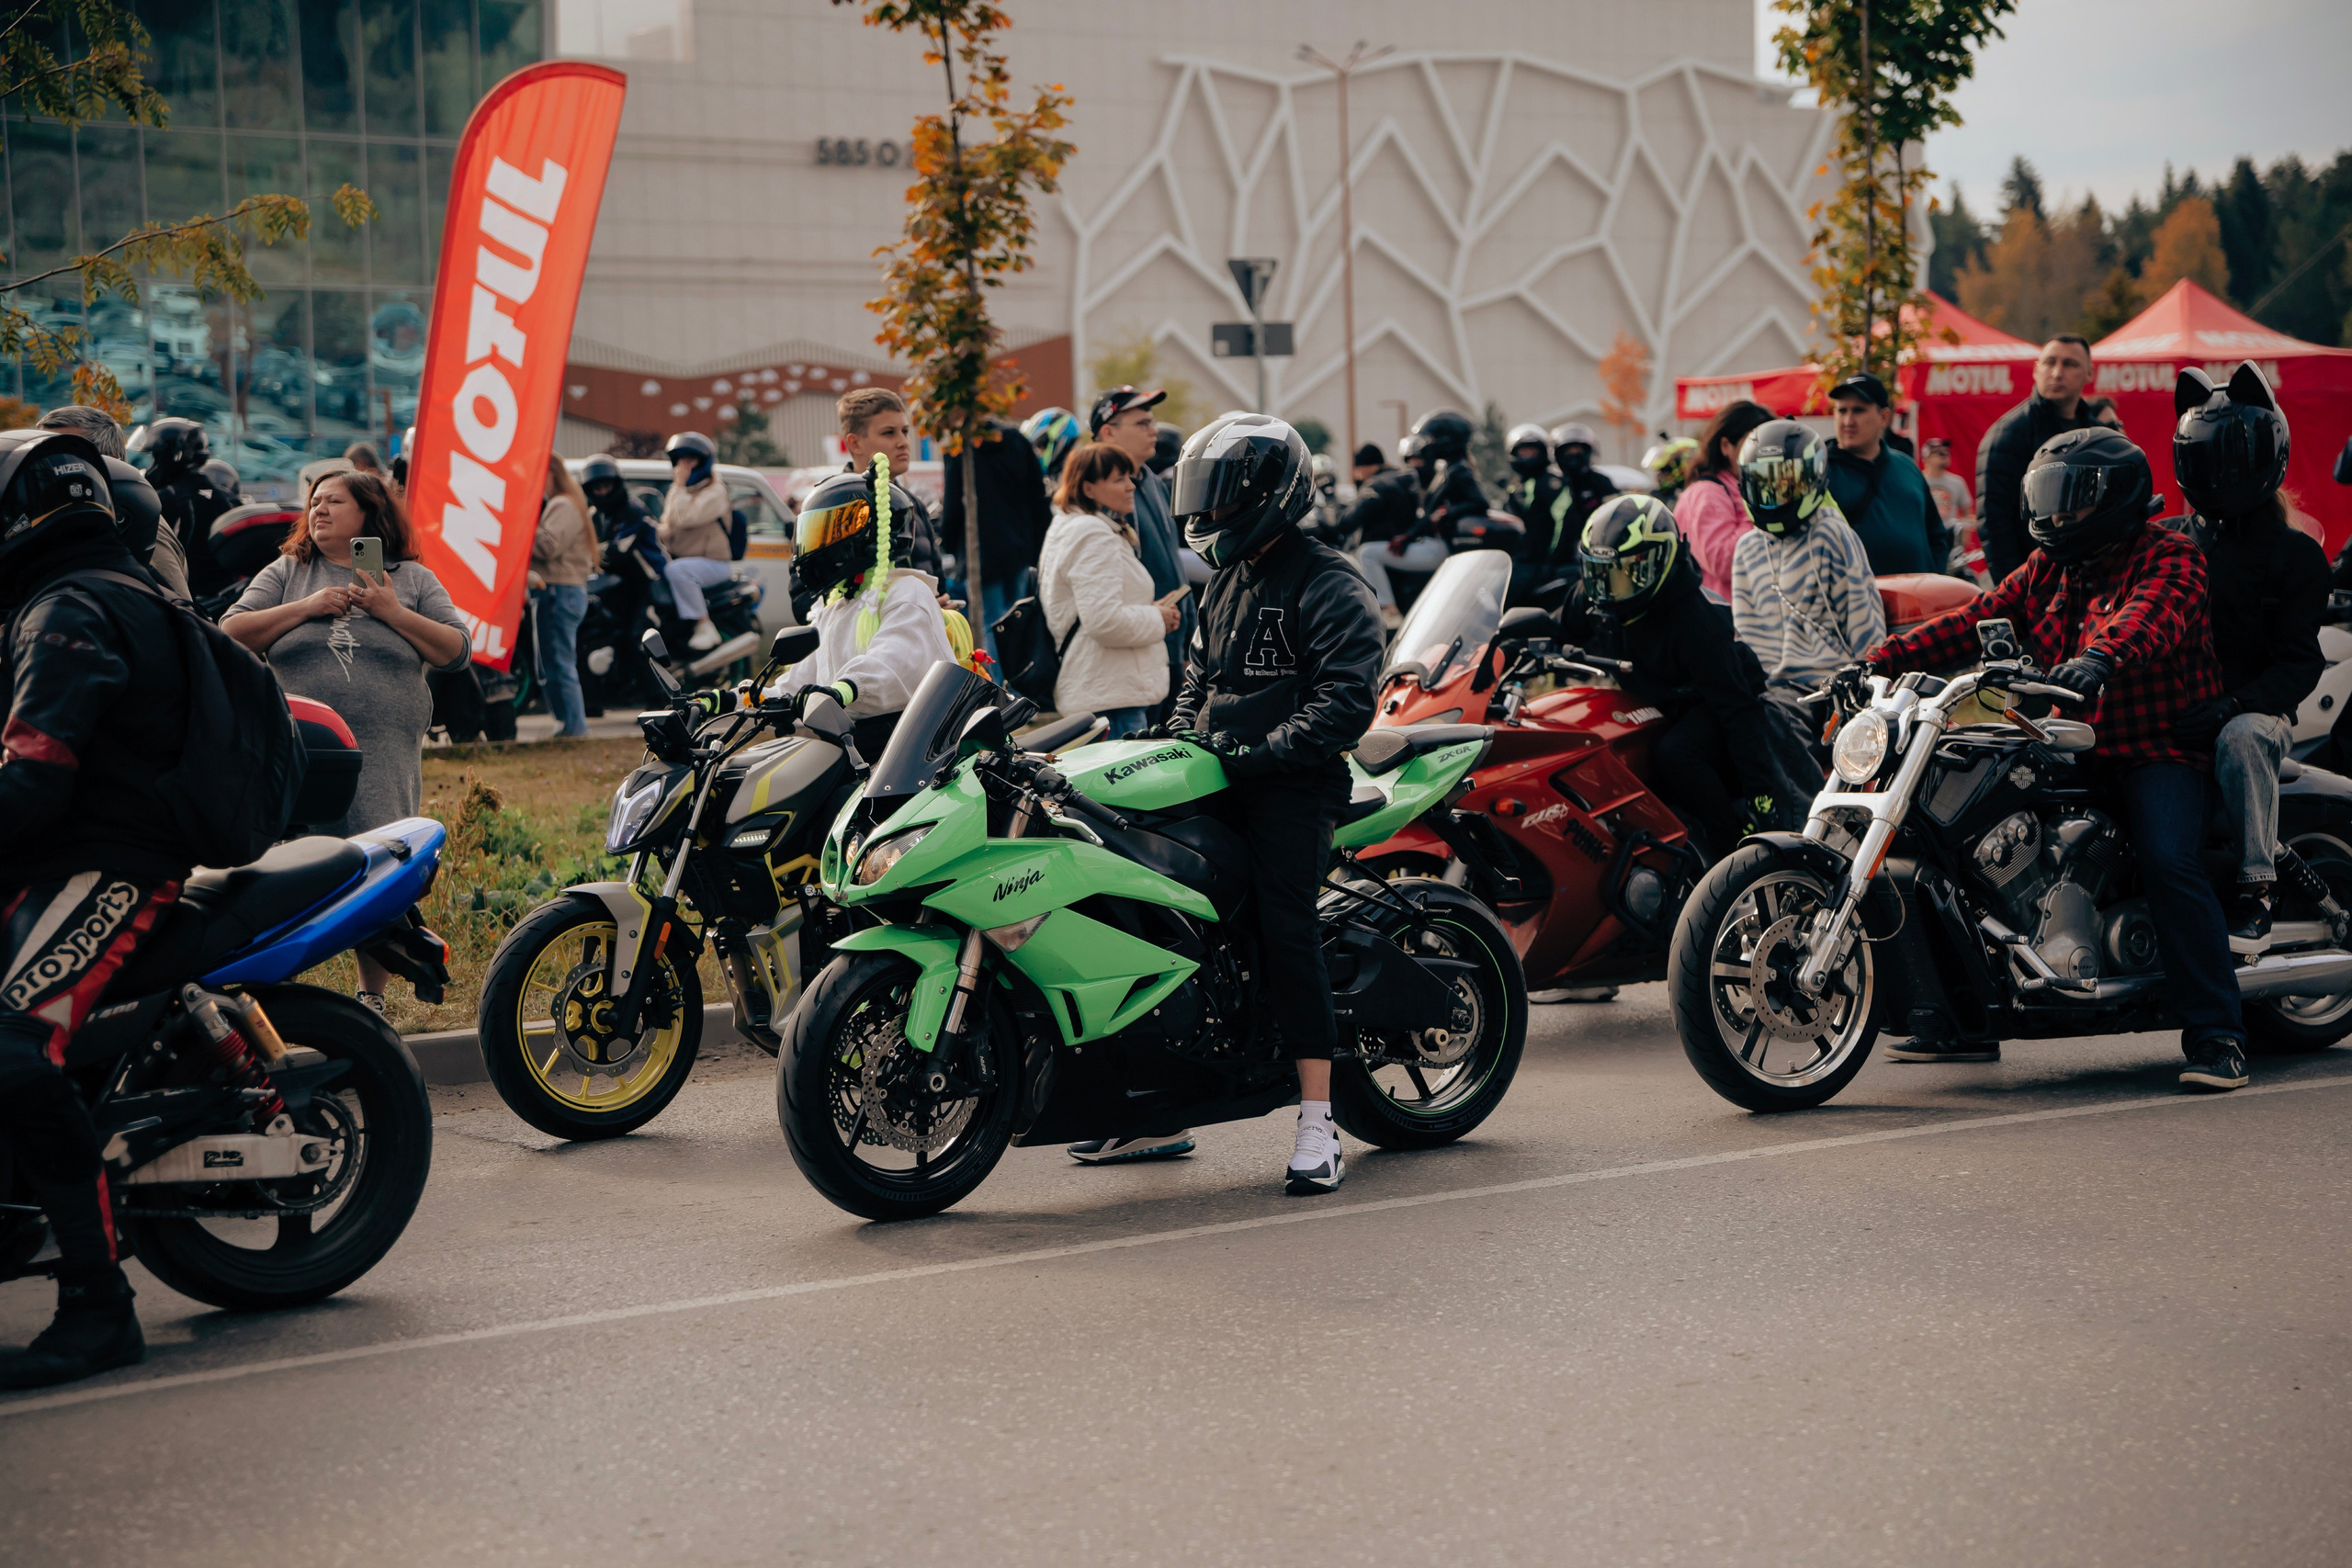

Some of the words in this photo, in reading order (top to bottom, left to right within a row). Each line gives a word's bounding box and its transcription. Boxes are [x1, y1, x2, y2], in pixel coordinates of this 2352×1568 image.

[440, 154, 569, 593] MOTUL
[1925, 364, 2015, 396] MOTUL
[2093, 362, 2177, 393] MOTUL
[53, 463, 86, 476] HIZER
[1279, 443, 1305, 510] SCORPION
[1245, 607, 1295, 666] A
[1103, 747, 1193, 785] Kawasaki
[993, 868, 1046, 902] Ninja
